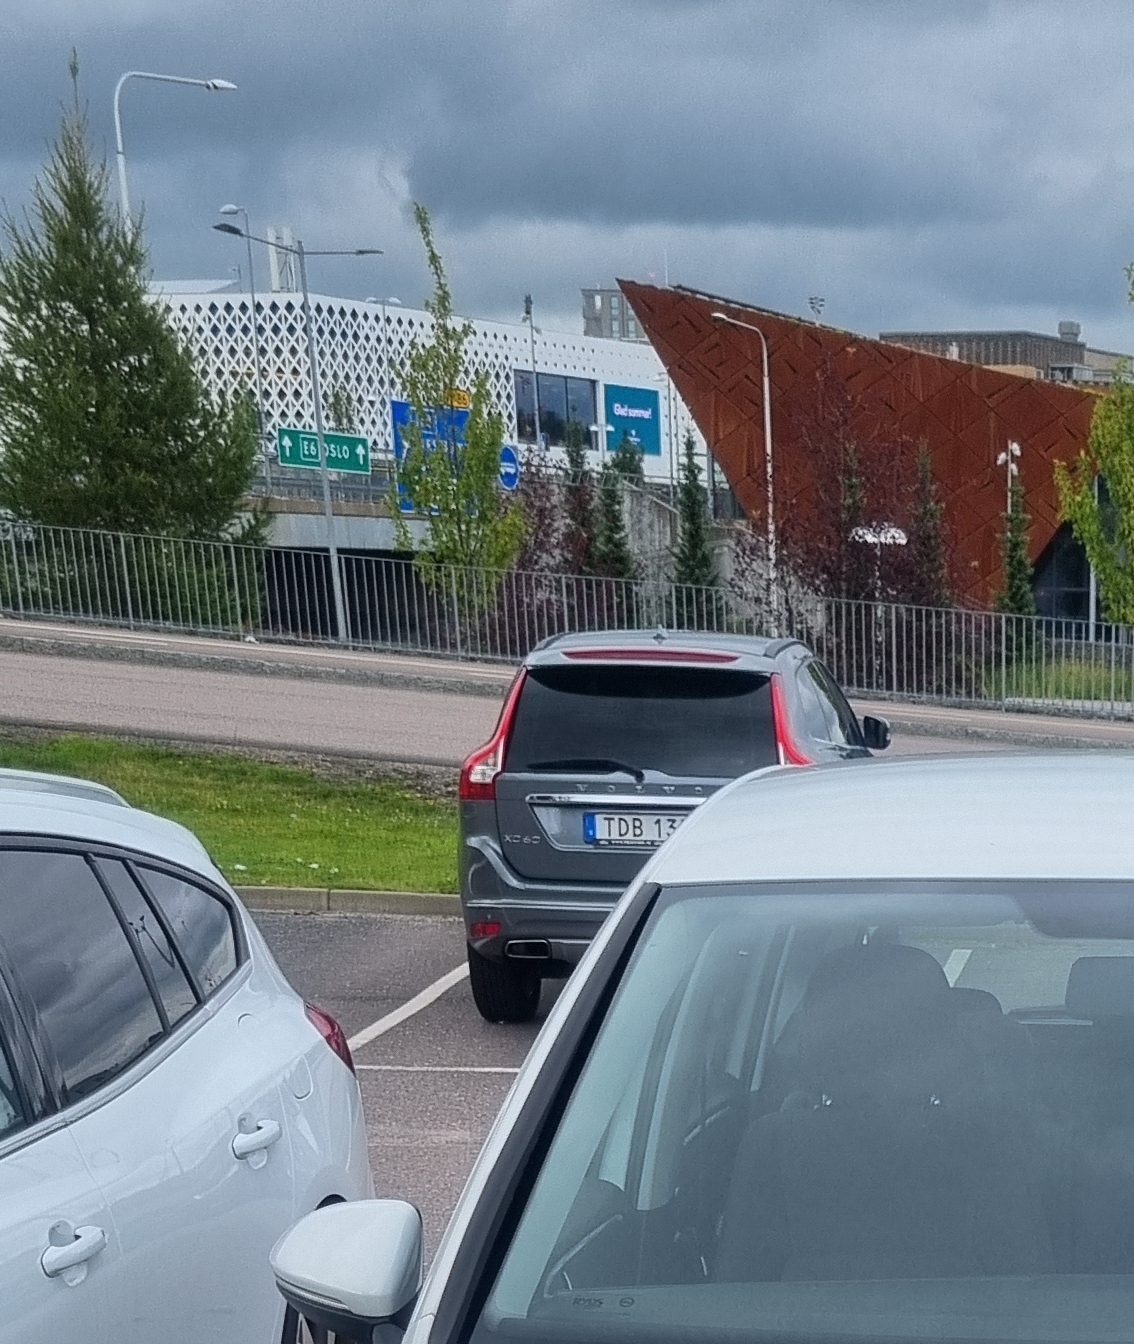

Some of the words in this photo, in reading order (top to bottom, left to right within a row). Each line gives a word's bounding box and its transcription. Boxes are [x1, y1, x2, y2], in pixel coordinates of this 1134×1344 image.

[304, 441, 316, 456] E6
[324, 444, 350, 459] OSLO
[576, 783, 703, 794] VOLVO
[604, 816, 643, 837] TDB
[654, 818, 681, 838] 13
[503, 834, 541, 845] XC60
